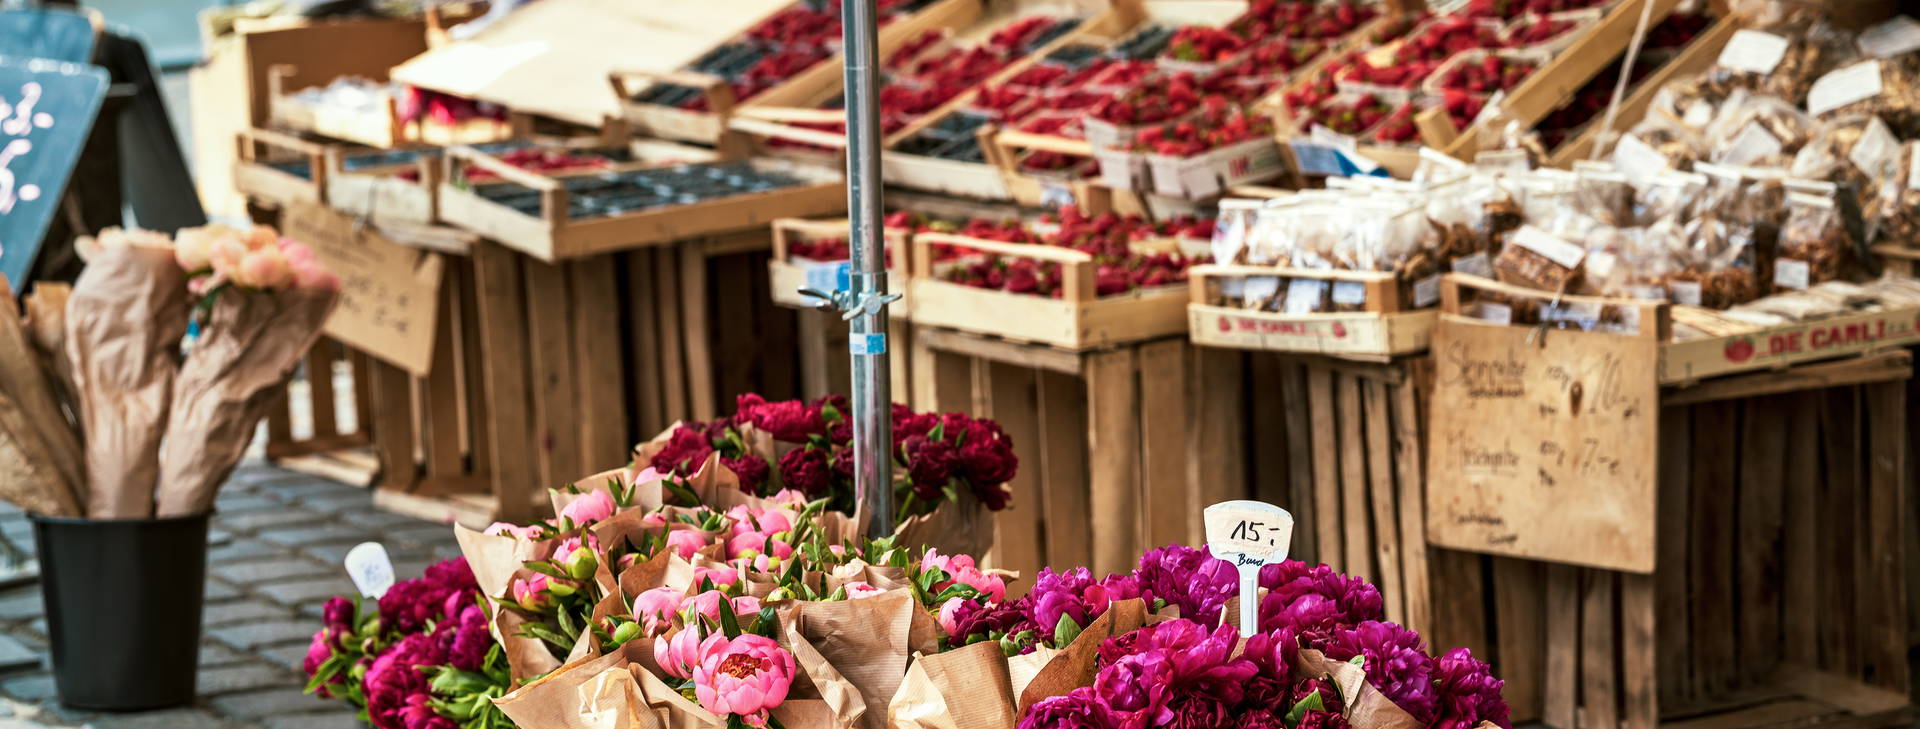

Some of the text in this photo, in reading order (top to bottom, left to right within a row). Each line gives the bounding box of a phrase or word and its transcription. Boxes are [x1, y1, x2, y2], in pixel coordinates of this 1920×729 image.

[1769, 319, 1886, 355] DE CARLI
[1237, 553, 1265, 567] Bund
